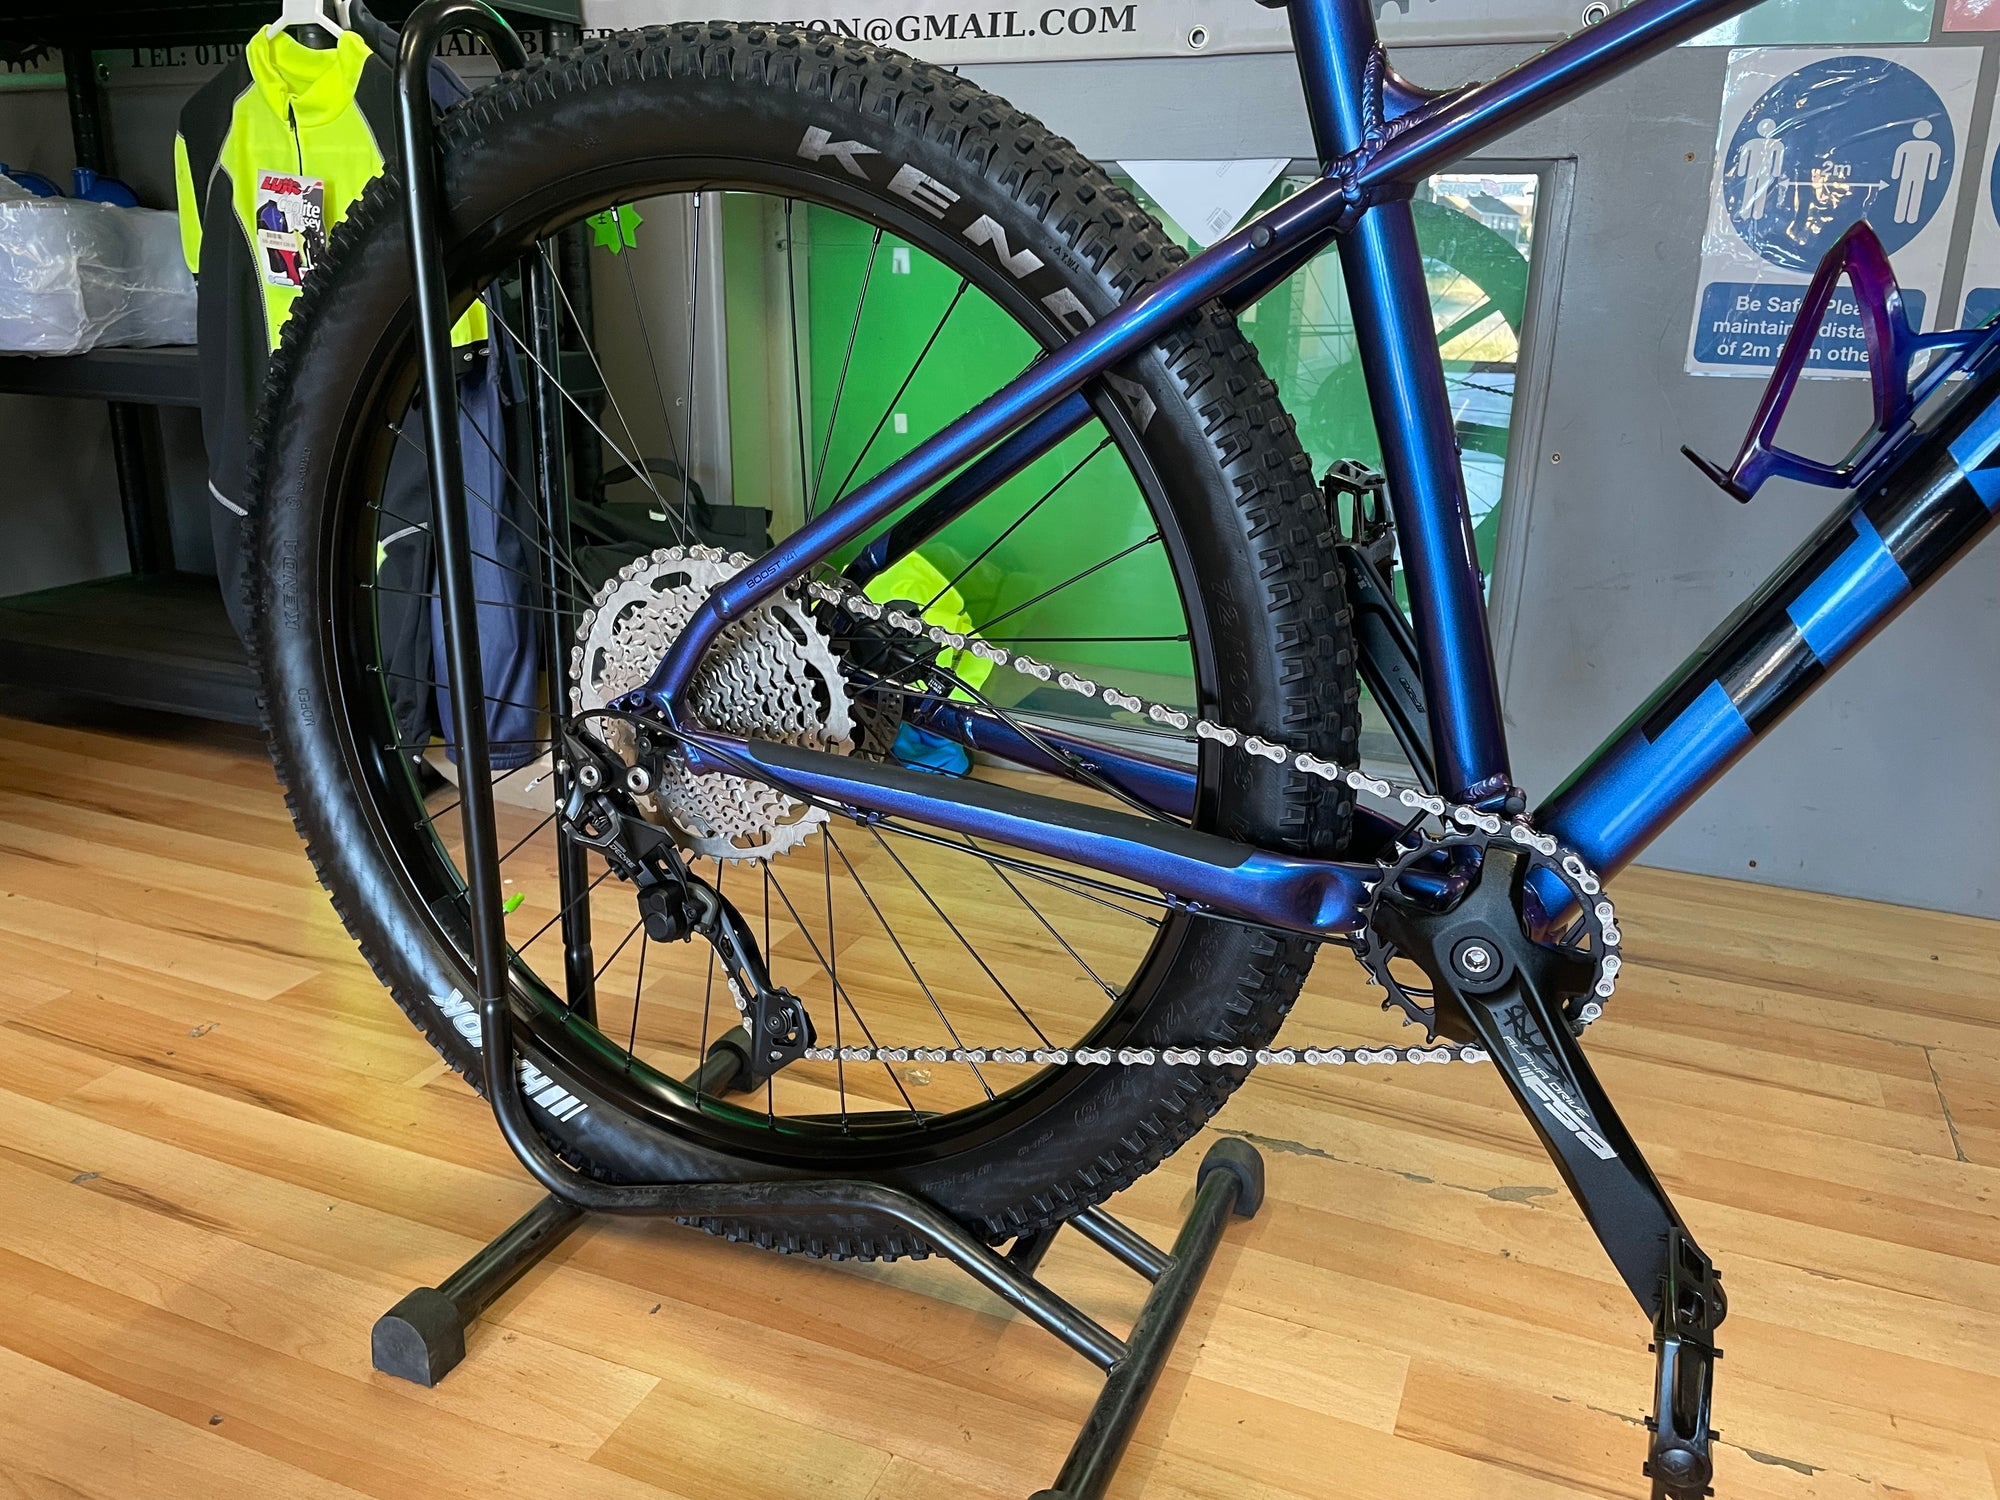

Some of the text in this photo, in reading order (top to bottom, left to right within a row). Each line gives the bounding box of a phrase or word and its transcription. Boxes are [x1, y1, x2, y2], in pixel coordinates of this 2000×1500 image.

[1821, 161, 1852, 178] 2m
[797, 125, 1158, 435] KENDA
[1735, 294, 1862, 316] Be Saf Plea
[1818, 322, 1867, 340] dista
[1716, 341, 1870, 363] of 2m fm othe
[745, 560, 781, 589] BOOST
[608, 843, 637, 869] DEORE
[1503, 1035, 1590, 1119] ALPHA DRIVE
